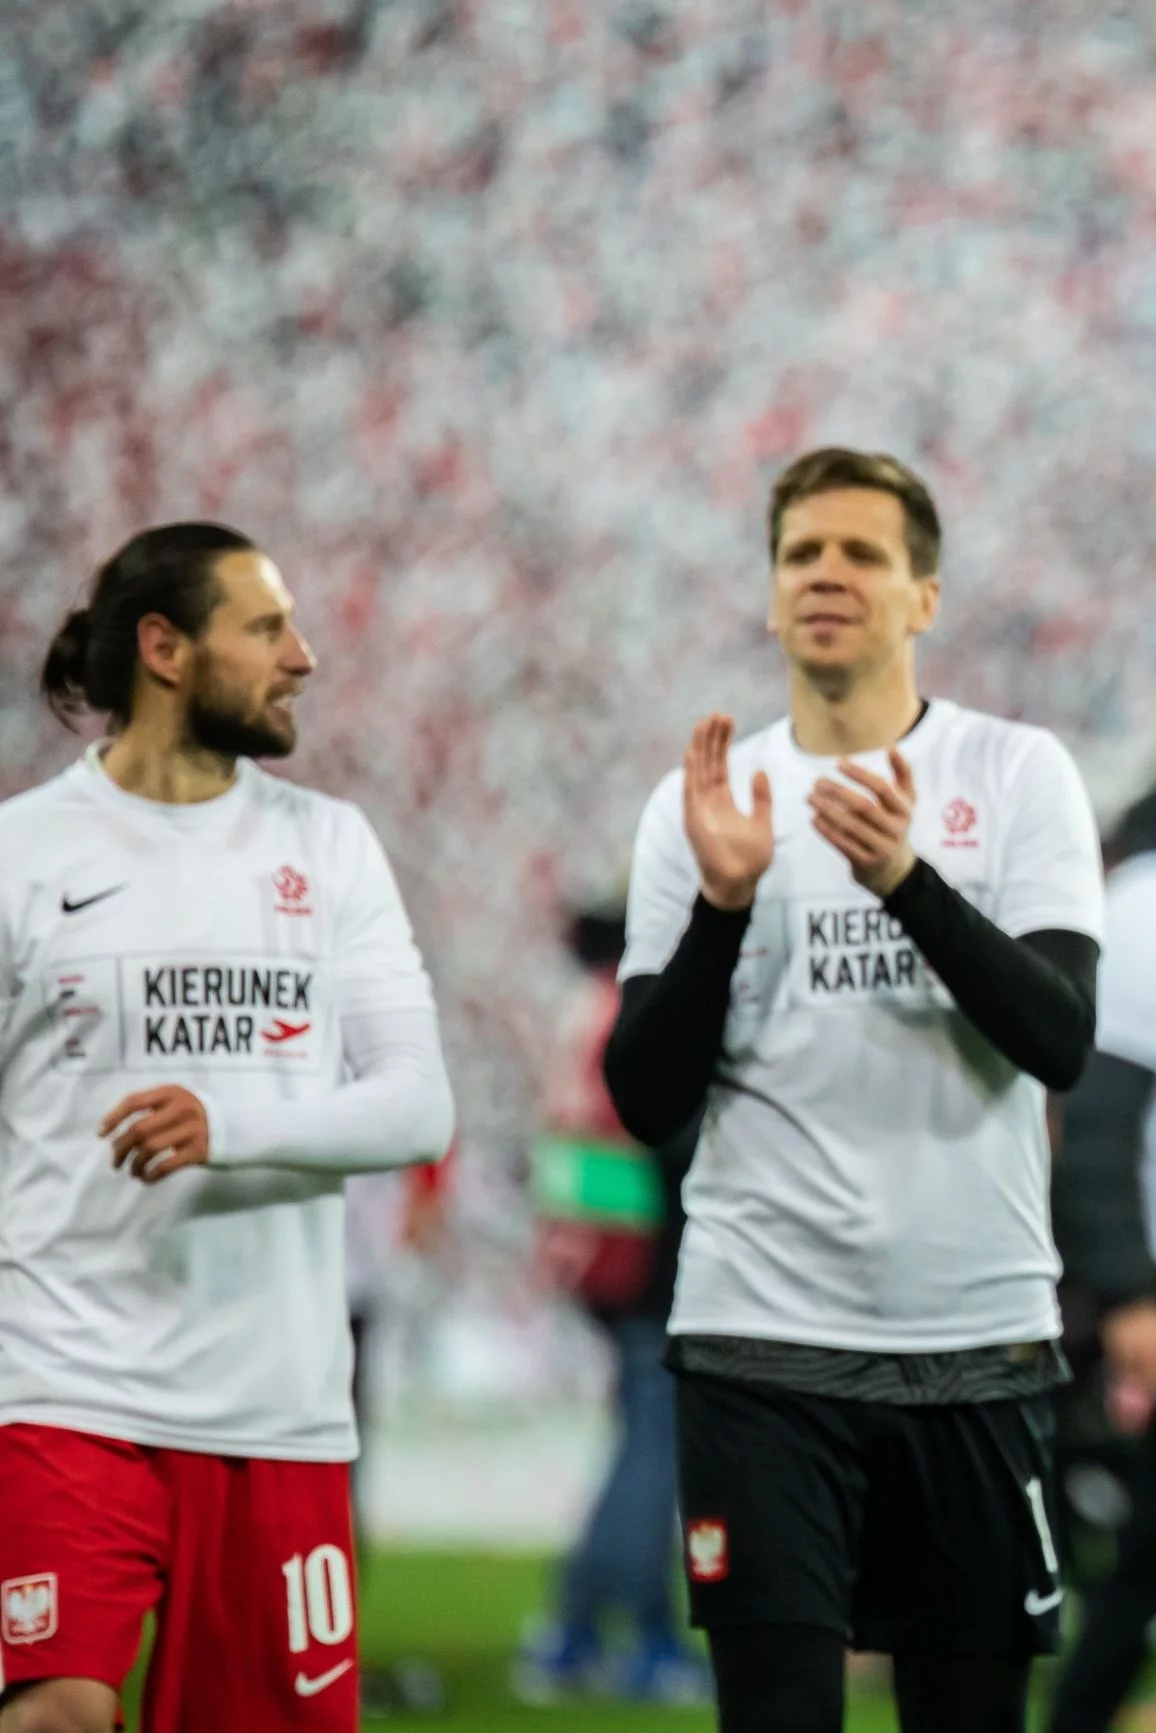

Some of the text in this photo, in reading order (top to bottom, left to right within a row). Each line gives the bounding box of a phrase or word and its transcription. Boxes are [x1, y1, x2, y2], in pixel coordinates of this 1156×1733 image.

[808, 909, 904, 947] KIERU
[144, 965, 314, 1011] KIERUNEK
[810, 949, 916, 992] KATAR
[145, 1015, 254, 1056] KATAR
[282, 1544, 353, 1653] 10
